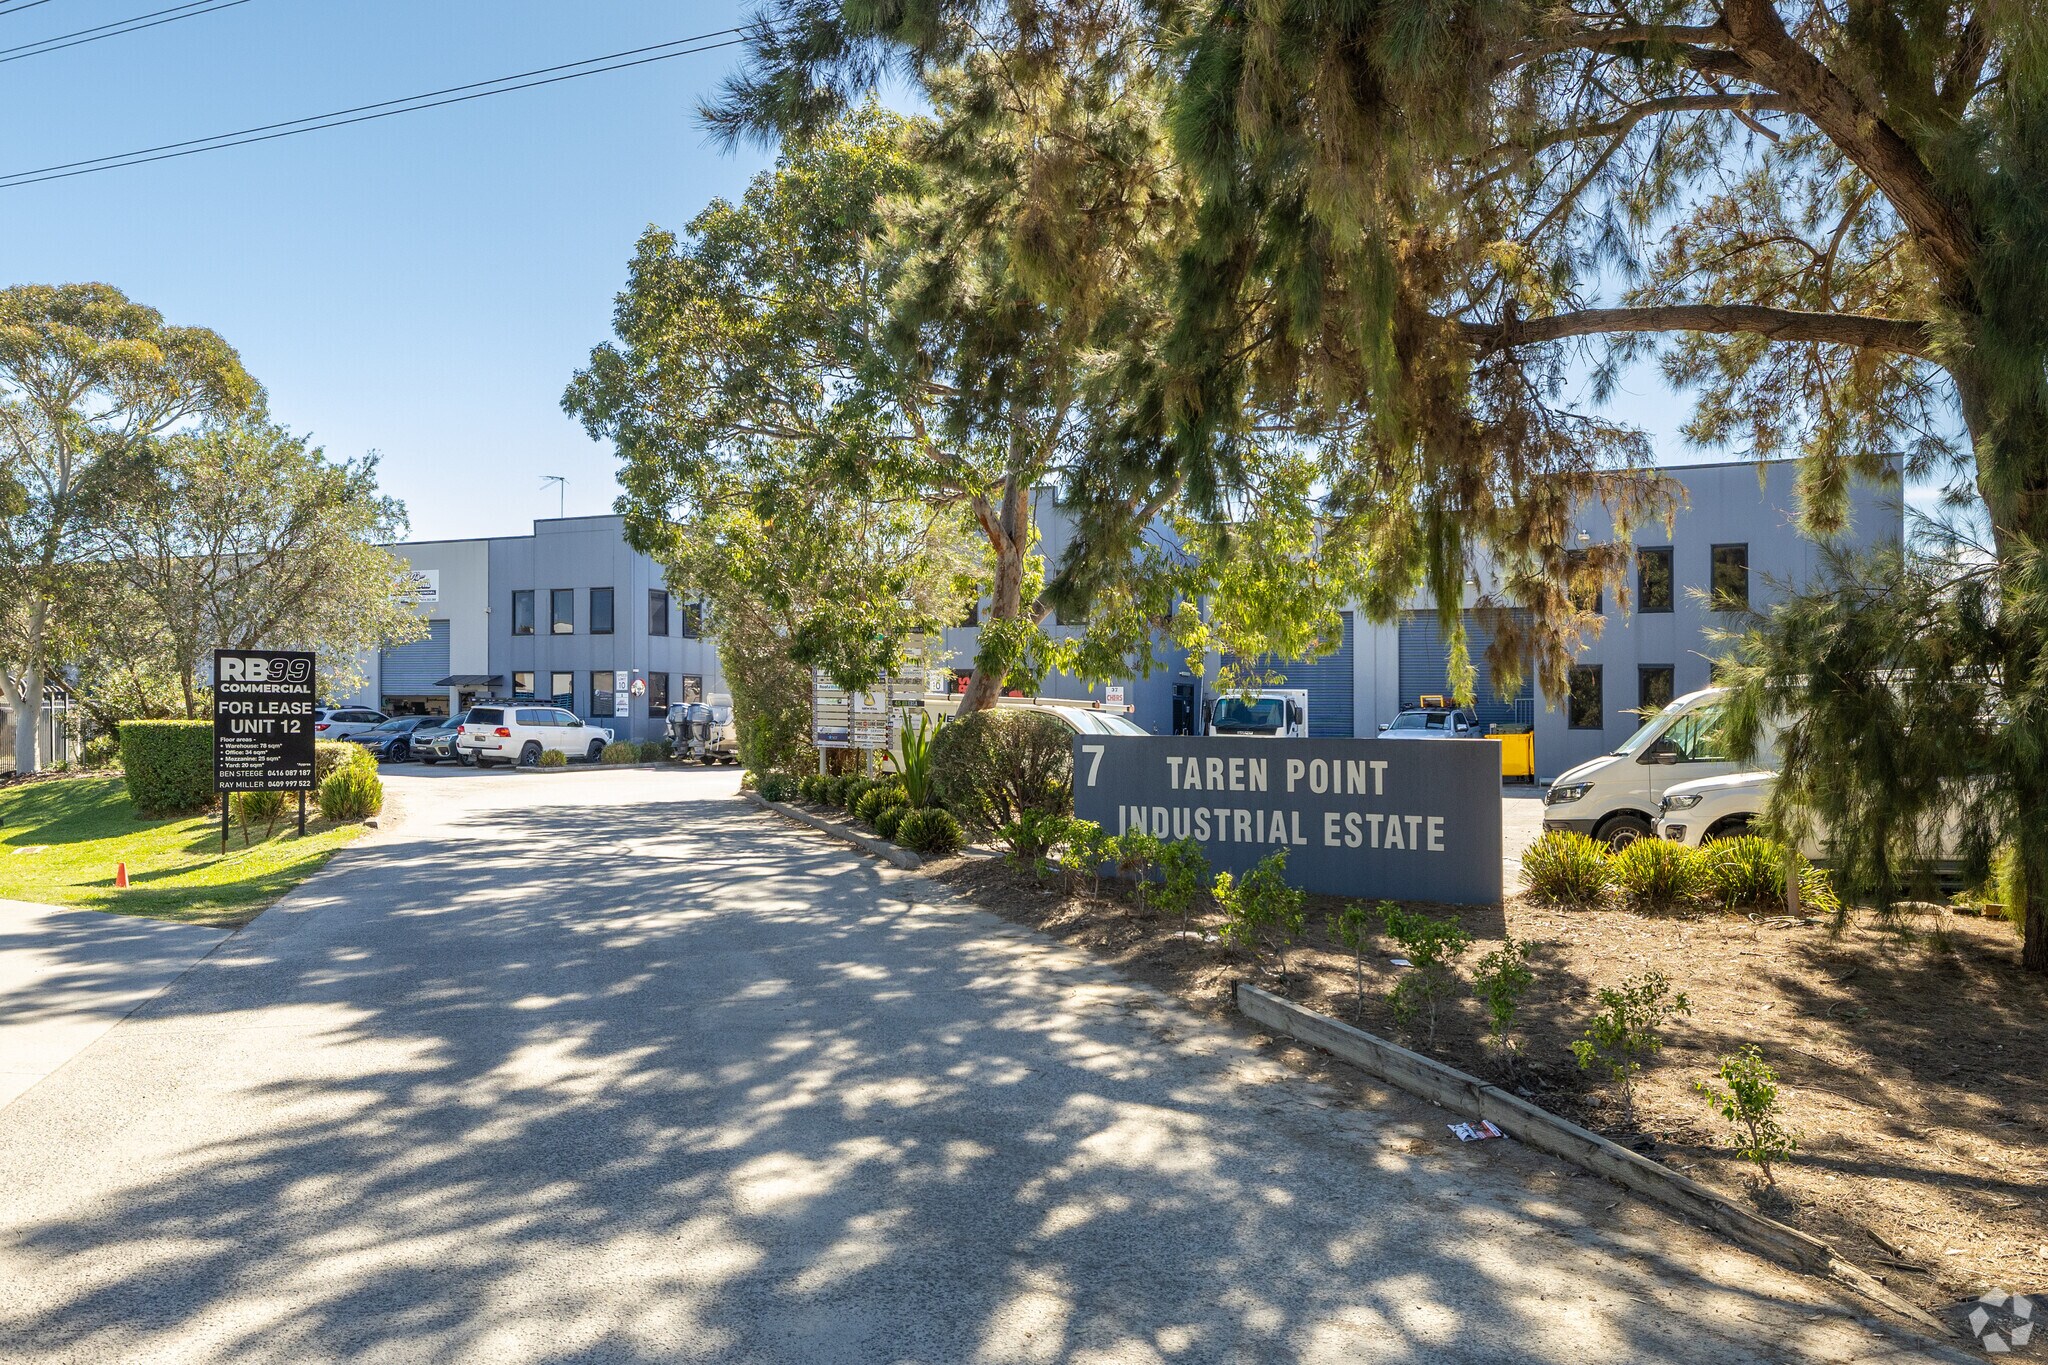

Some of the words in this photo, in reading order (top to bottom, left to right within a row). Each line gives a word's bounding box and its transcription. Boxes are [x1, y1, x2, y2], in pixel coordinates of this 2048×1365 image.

[220, 657, 310, 682] RB99
[220, 684, 311, 693] COMMERCIAL
[218, 702, 253, 714] FOR
[258, 702, 312, 714] LEASE
[231, 720, 275, 733] UNIT
[280, 720, 300, 733] 12
[1082, 745, 1104, 786] 7
[1166, 756, 1267, 791] TAREN
[1286, 758, 1388, 795] POINT
[1119, 805, 1308, 845] INDUSTRIAL
[1324, 812, 1444, 851] ESTATE
